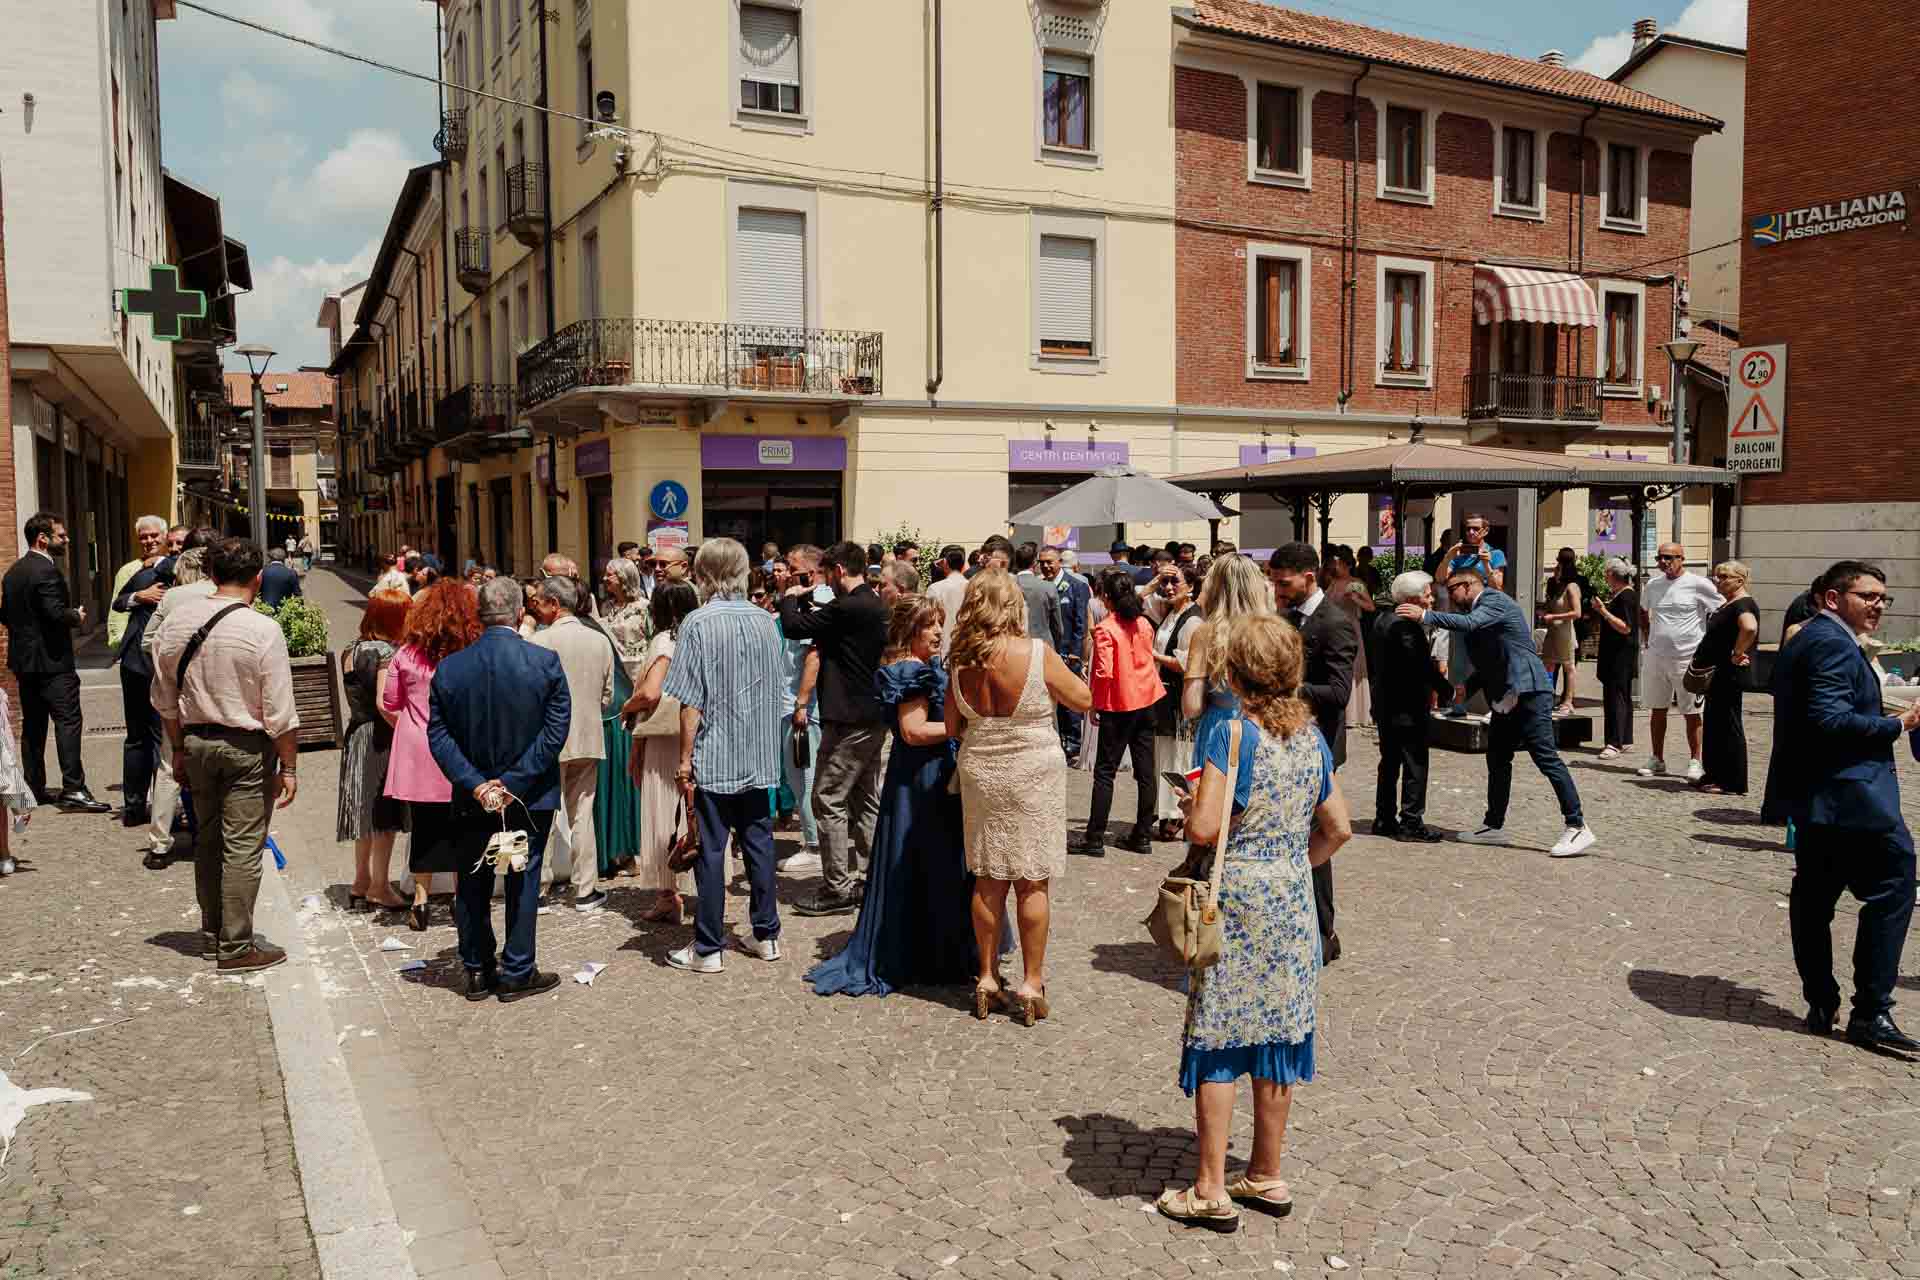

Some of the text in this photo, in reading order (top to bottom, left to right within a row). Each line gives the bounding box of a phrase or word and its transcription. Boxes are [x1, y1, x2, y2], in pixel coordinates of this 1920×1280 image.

[1785, 191, 1905, 227] ITALIANA
[1785, 209, 1905, 240] ASSICURAZIONI
[762, 446, 790, 457] PRIMO
[1734, 441, 1775, 454] BALCONI
[1728, 457, 1780, 471] SPORGENTI
